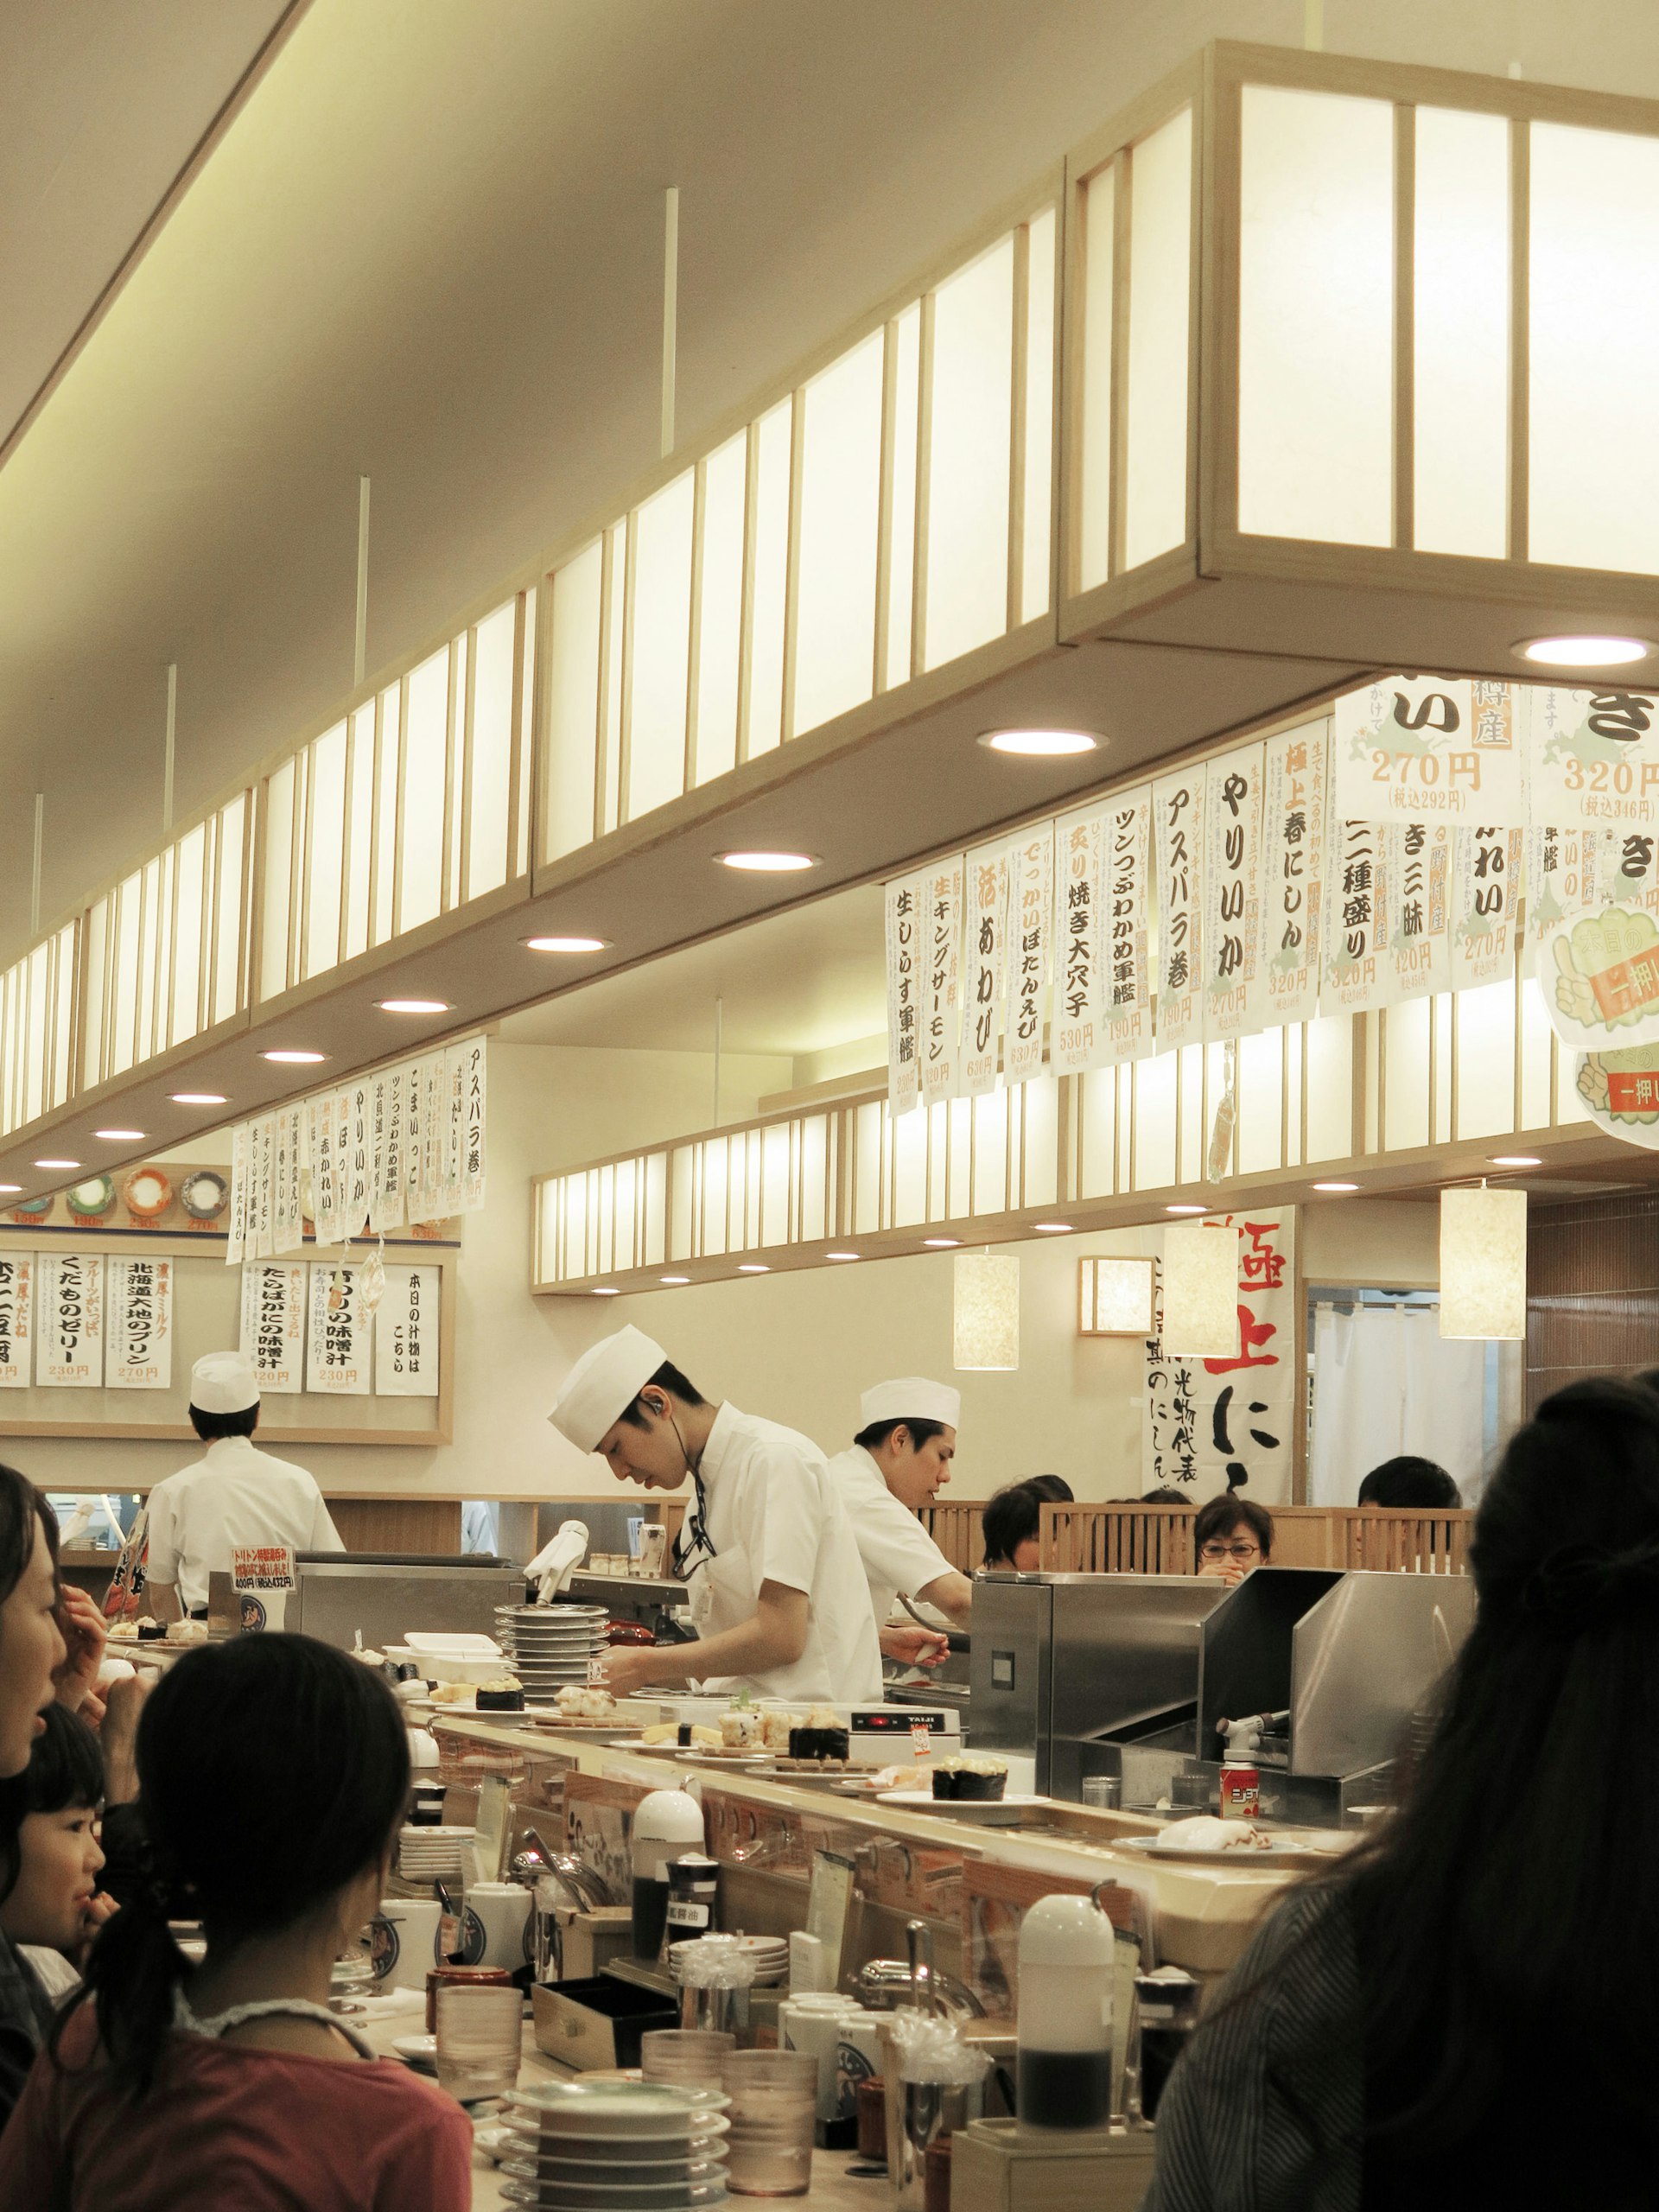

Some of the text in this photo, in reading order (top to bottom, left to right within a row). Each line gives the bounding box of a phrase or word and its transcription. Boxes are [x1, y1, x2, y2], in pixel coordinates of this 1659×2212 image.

[1372, 751, 1480, 791] 270円
[1168, 789, 1189, 988] アスパラ巻
[1218, 772, 1248, 977] やりいか
[1281, 741, 1307, 950] 極上春にしん
[1430, 848, 1448, 931] 野付産
[1065, 825, 1090, 1018] 炙り焼き大穴子
[1113, 809, 1135, 1005] ツンつぶわかめ軍艦
[1465, 925, 1506, 960] 270円
[1580, 929, 1643, 954] 本日の
[897, 889, 914, 1064] 生しらす軍艦
[931, 876, 951, 1062] 生キングサーモン
[1212, 984, 1247, 1015] 270円
[1269, 968, 1307, 995] 320円
[1332, 957, 1376, 988] 320円
[1060, 1022, 1093, 1051] 530円
[353, 1090, 365, 1202] やりいか
[467, 1048, 480, 1173] アスパラ巻
[188, 1219, 219, 1231] 270円
[58, 1256, 83, 1363] くだものゼリー
[126, 1262, 154, 1364] 北海道大地のプリン
[156, 1262, 169, 1340] 濃厚ミルク
[258, 1267, 286, 1369] たらばがにの味噌汁
[409, 1274, 421, 1373] 本日の汁物は
[48, 1365, 89, 1376] 230円
[118, 1367, 158, 1378] 270円
[319, 1370, 357, 1382] 230円
[393, 1325, 404, 1373] こちら
[1168, 1357, 1198, 1483] 光物代表
